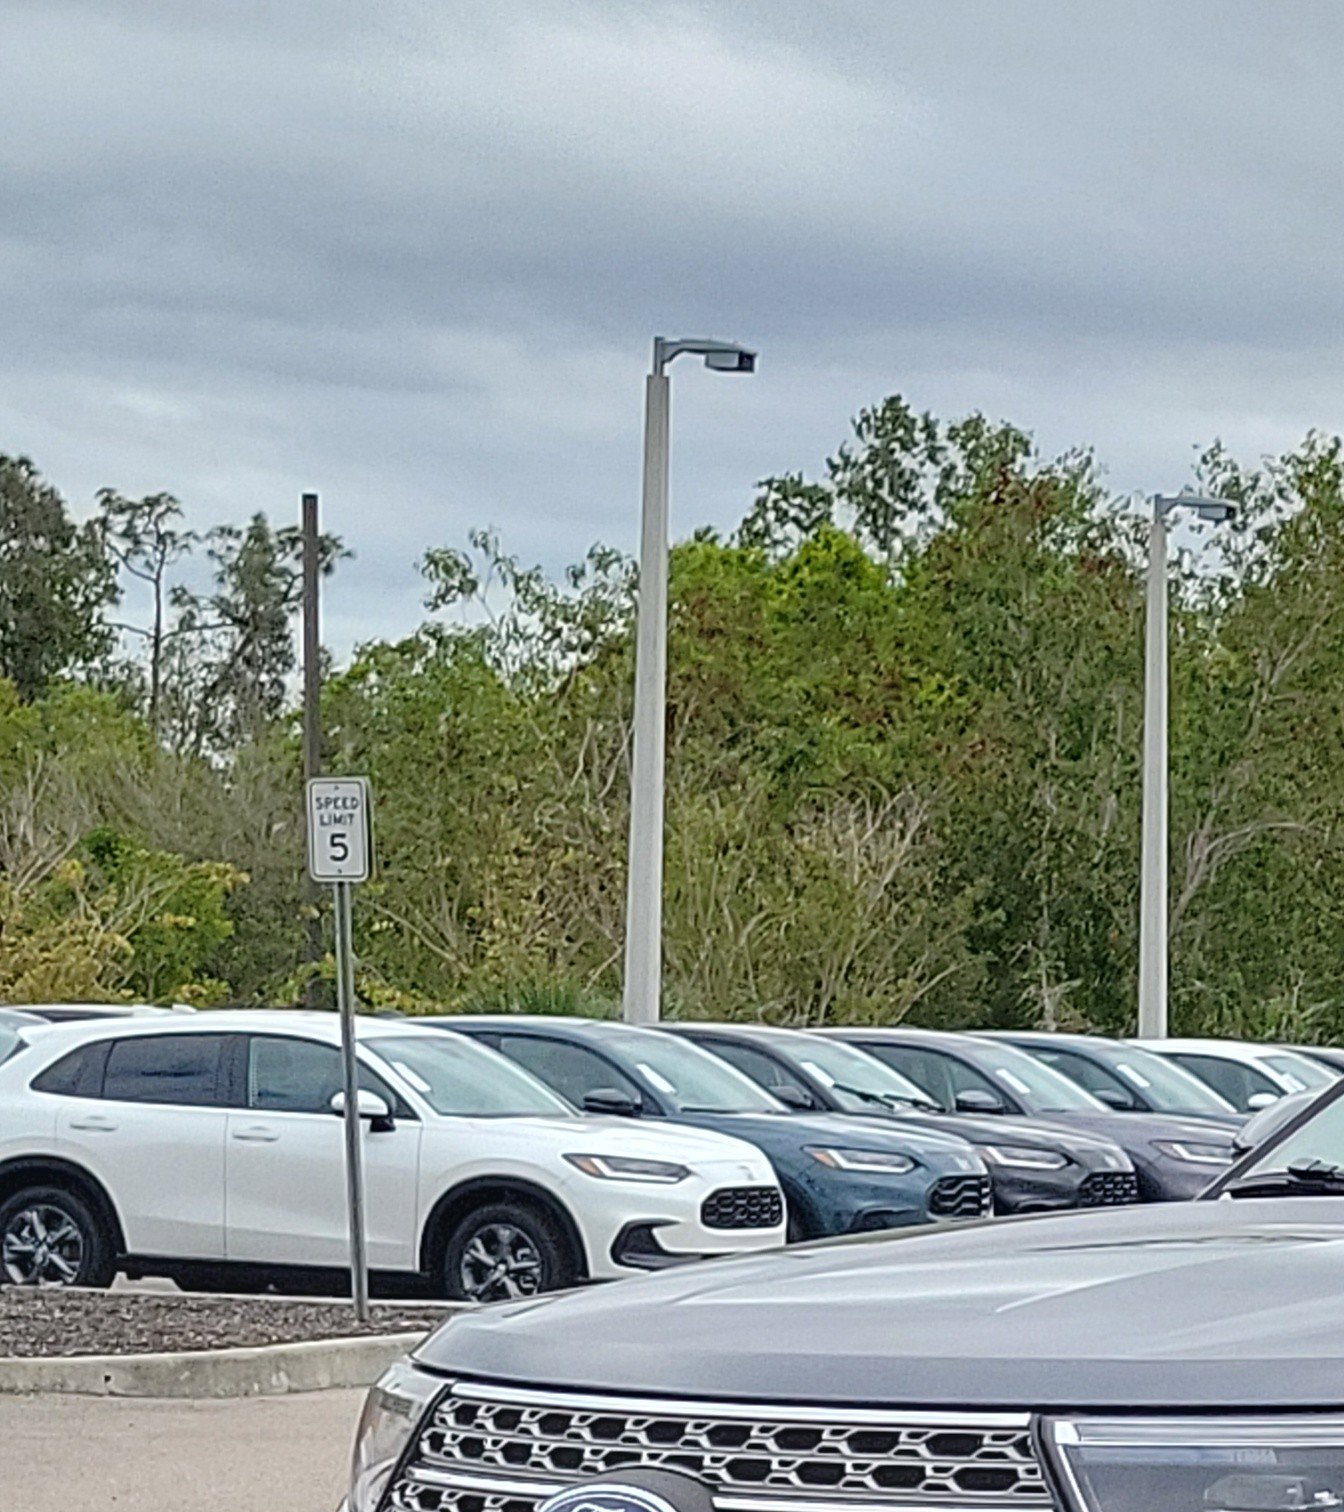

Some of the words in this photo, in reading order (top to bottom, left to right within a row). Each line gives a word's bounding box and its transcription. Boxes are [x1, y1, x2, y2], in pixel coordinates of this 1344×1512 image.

[315, 796, 359, 811] SPEED
[319, 813, 355, 827] LIMIT
[329, 832, 350, 862] 5
